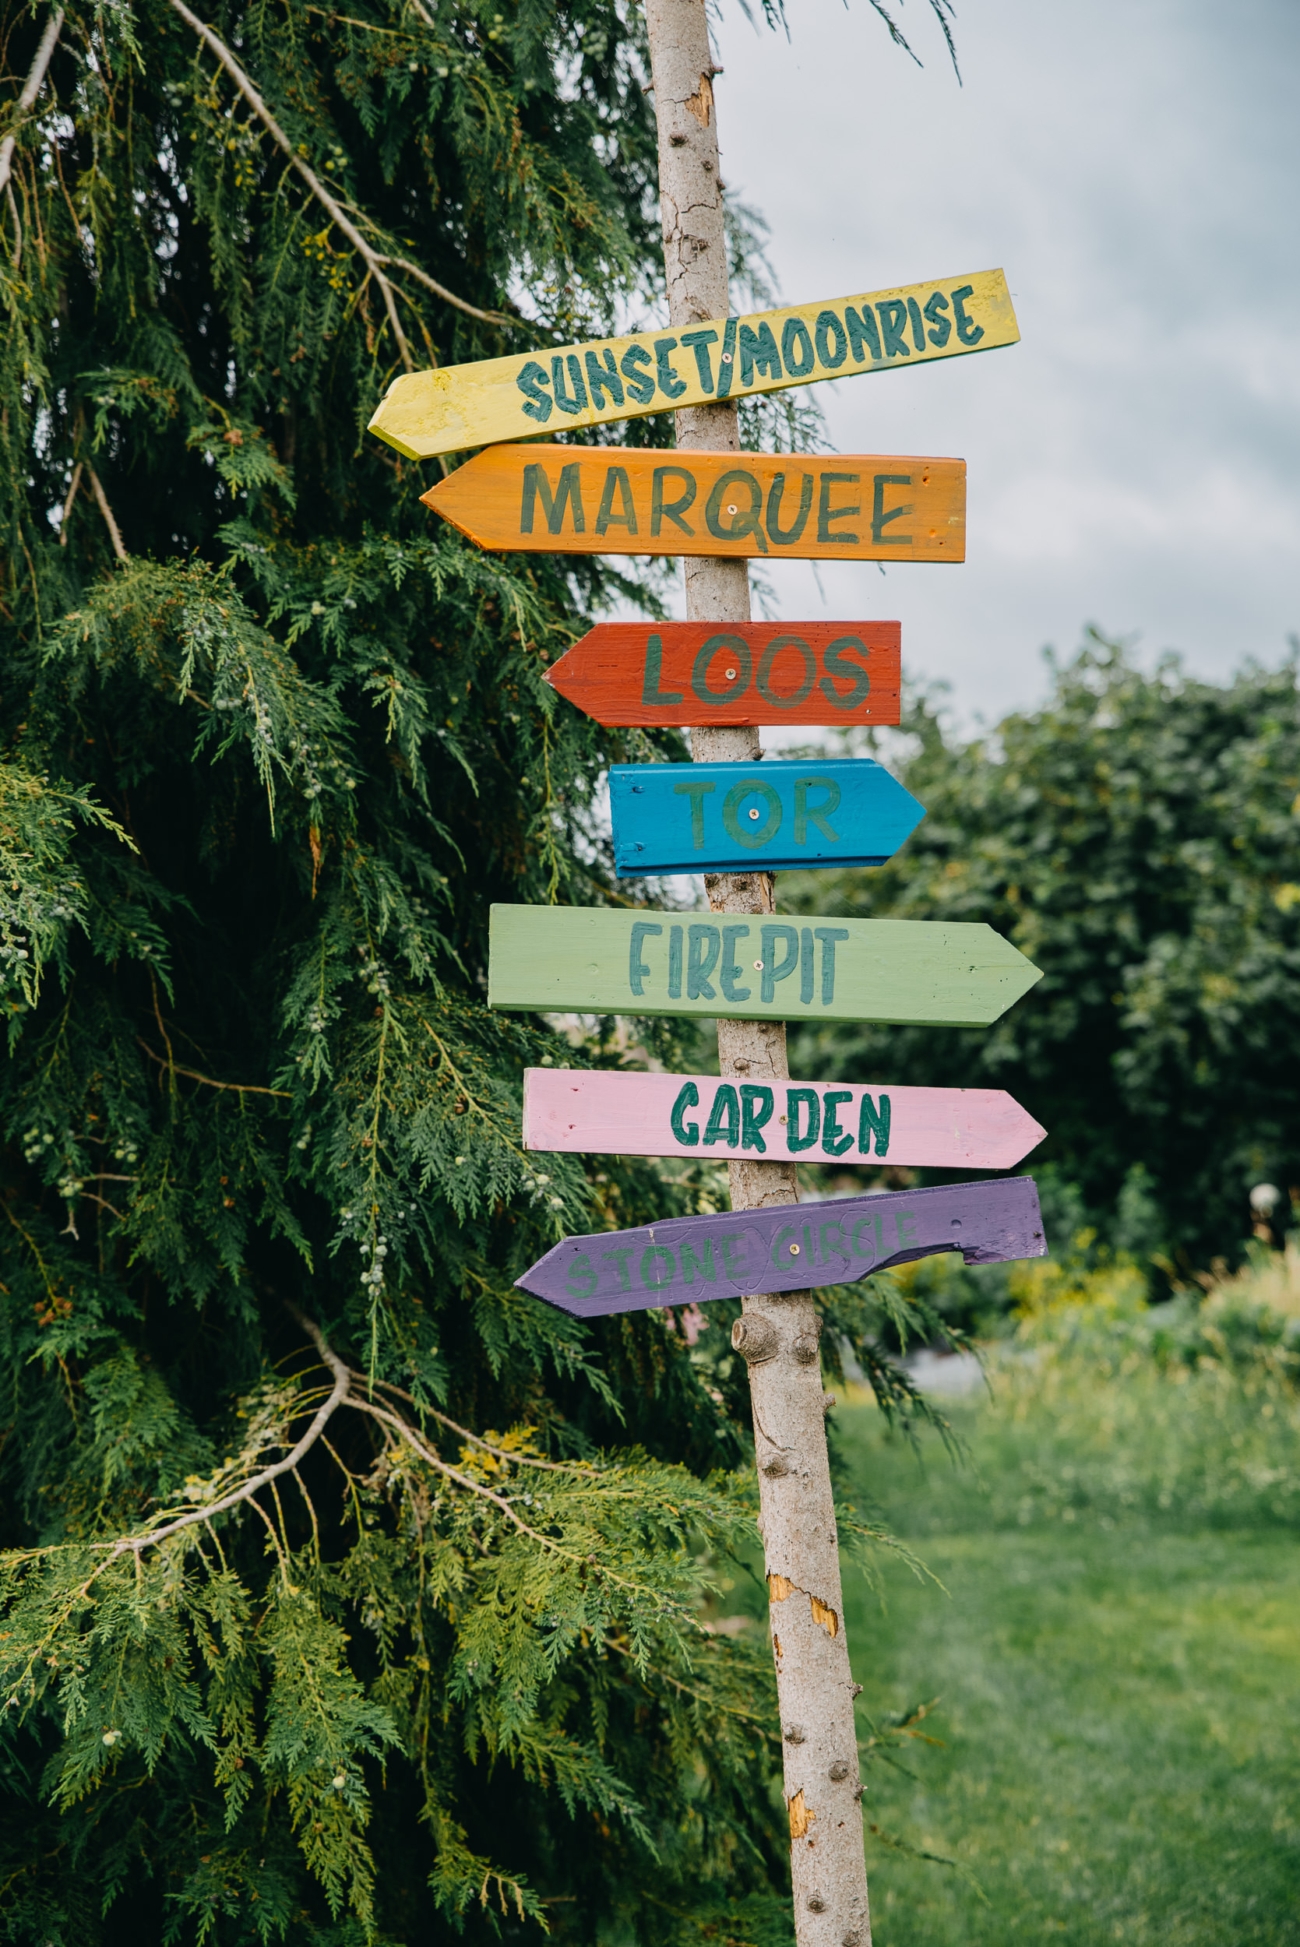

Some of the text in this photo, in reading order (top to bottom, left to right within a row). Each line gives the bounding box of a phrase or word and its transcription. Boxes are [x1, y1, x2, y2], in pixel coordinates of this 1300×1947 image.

[516, 284, 984, 423] SUNSET/MOONRISE
[520, 462, 913, 553] MARQUEE
[641, 634, 871, 710] LOOS
[674, 776, 842, 850] TOR
[670, 1081, 891, 1157] GARDEN
[564, 1232, 751, 1299] STONE
